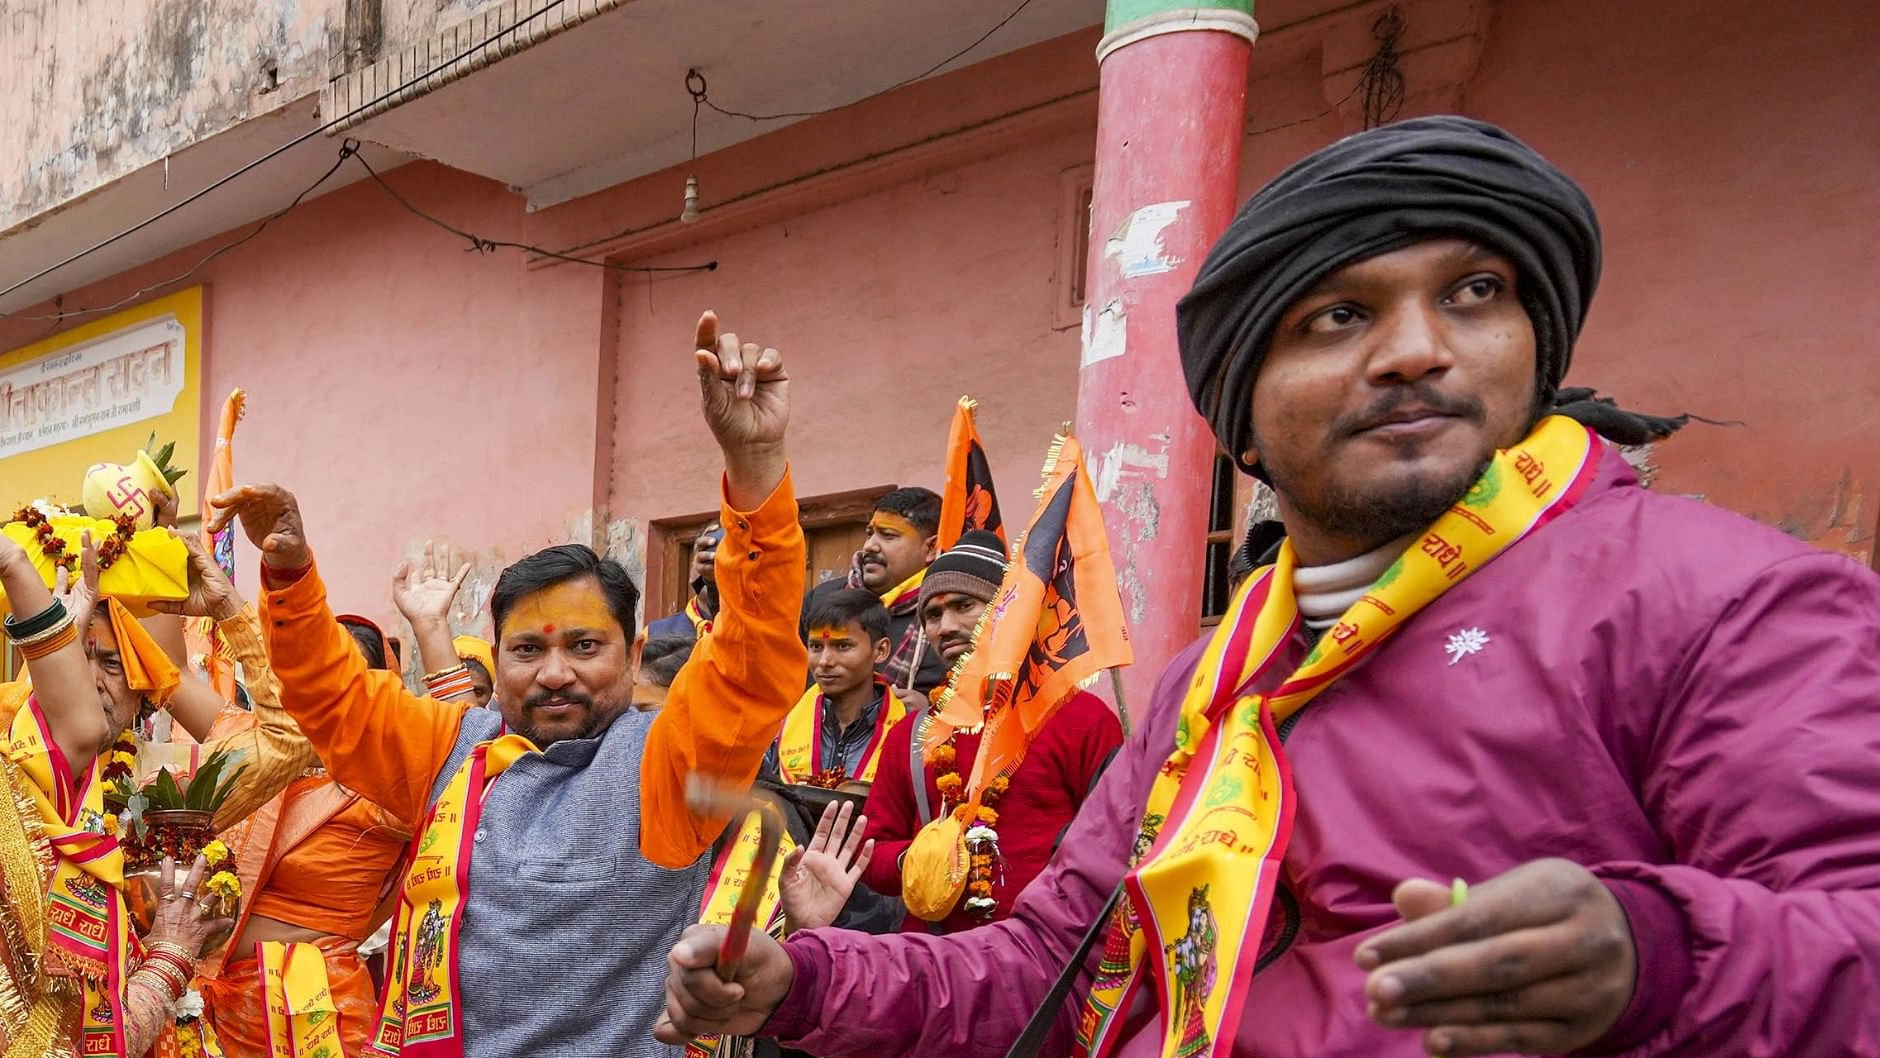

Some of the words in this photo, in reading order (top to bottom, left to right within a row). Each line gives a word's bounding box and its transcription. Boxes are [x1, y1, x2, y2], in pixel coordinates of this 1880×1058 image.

[1514, 450, 1546, 486] राधे
[1421, 533, 1463, 569] राधे
[50, 906, 76, 929] राधे
[79, 918, 106, 939] राधे
[85, 1033, 112, 1053] राधे
[383, 1028, 401, 1046] राधे
